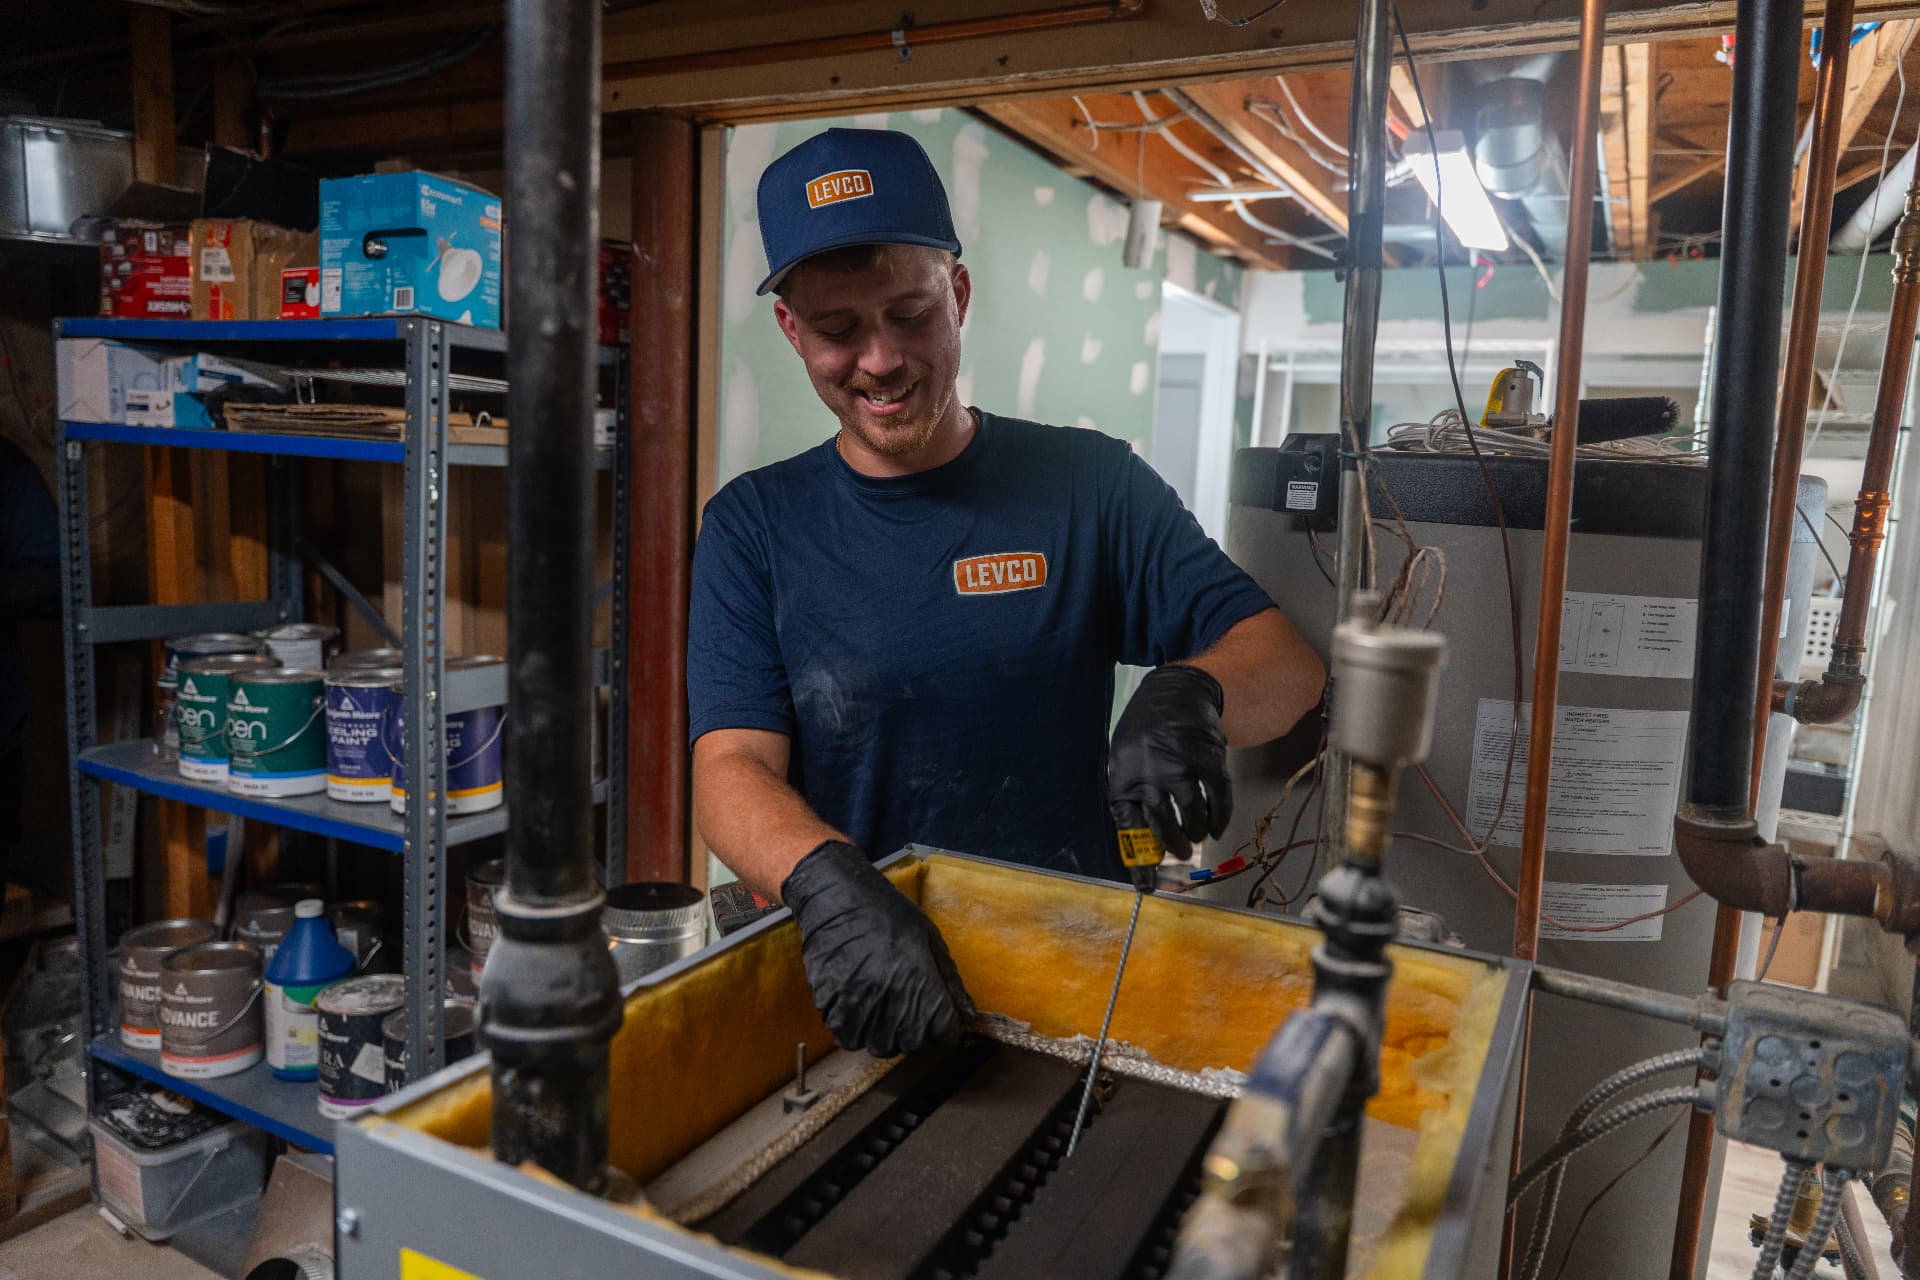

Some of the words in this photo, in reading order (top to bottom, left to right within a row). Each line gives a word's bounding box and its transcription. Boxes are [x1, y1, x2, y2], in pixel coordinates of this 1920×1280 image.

[813, 174, 865, 202] LEVCO
[965, 558, 1037, 588] LEVCO
[331, 737, 370, 746] PAINT
